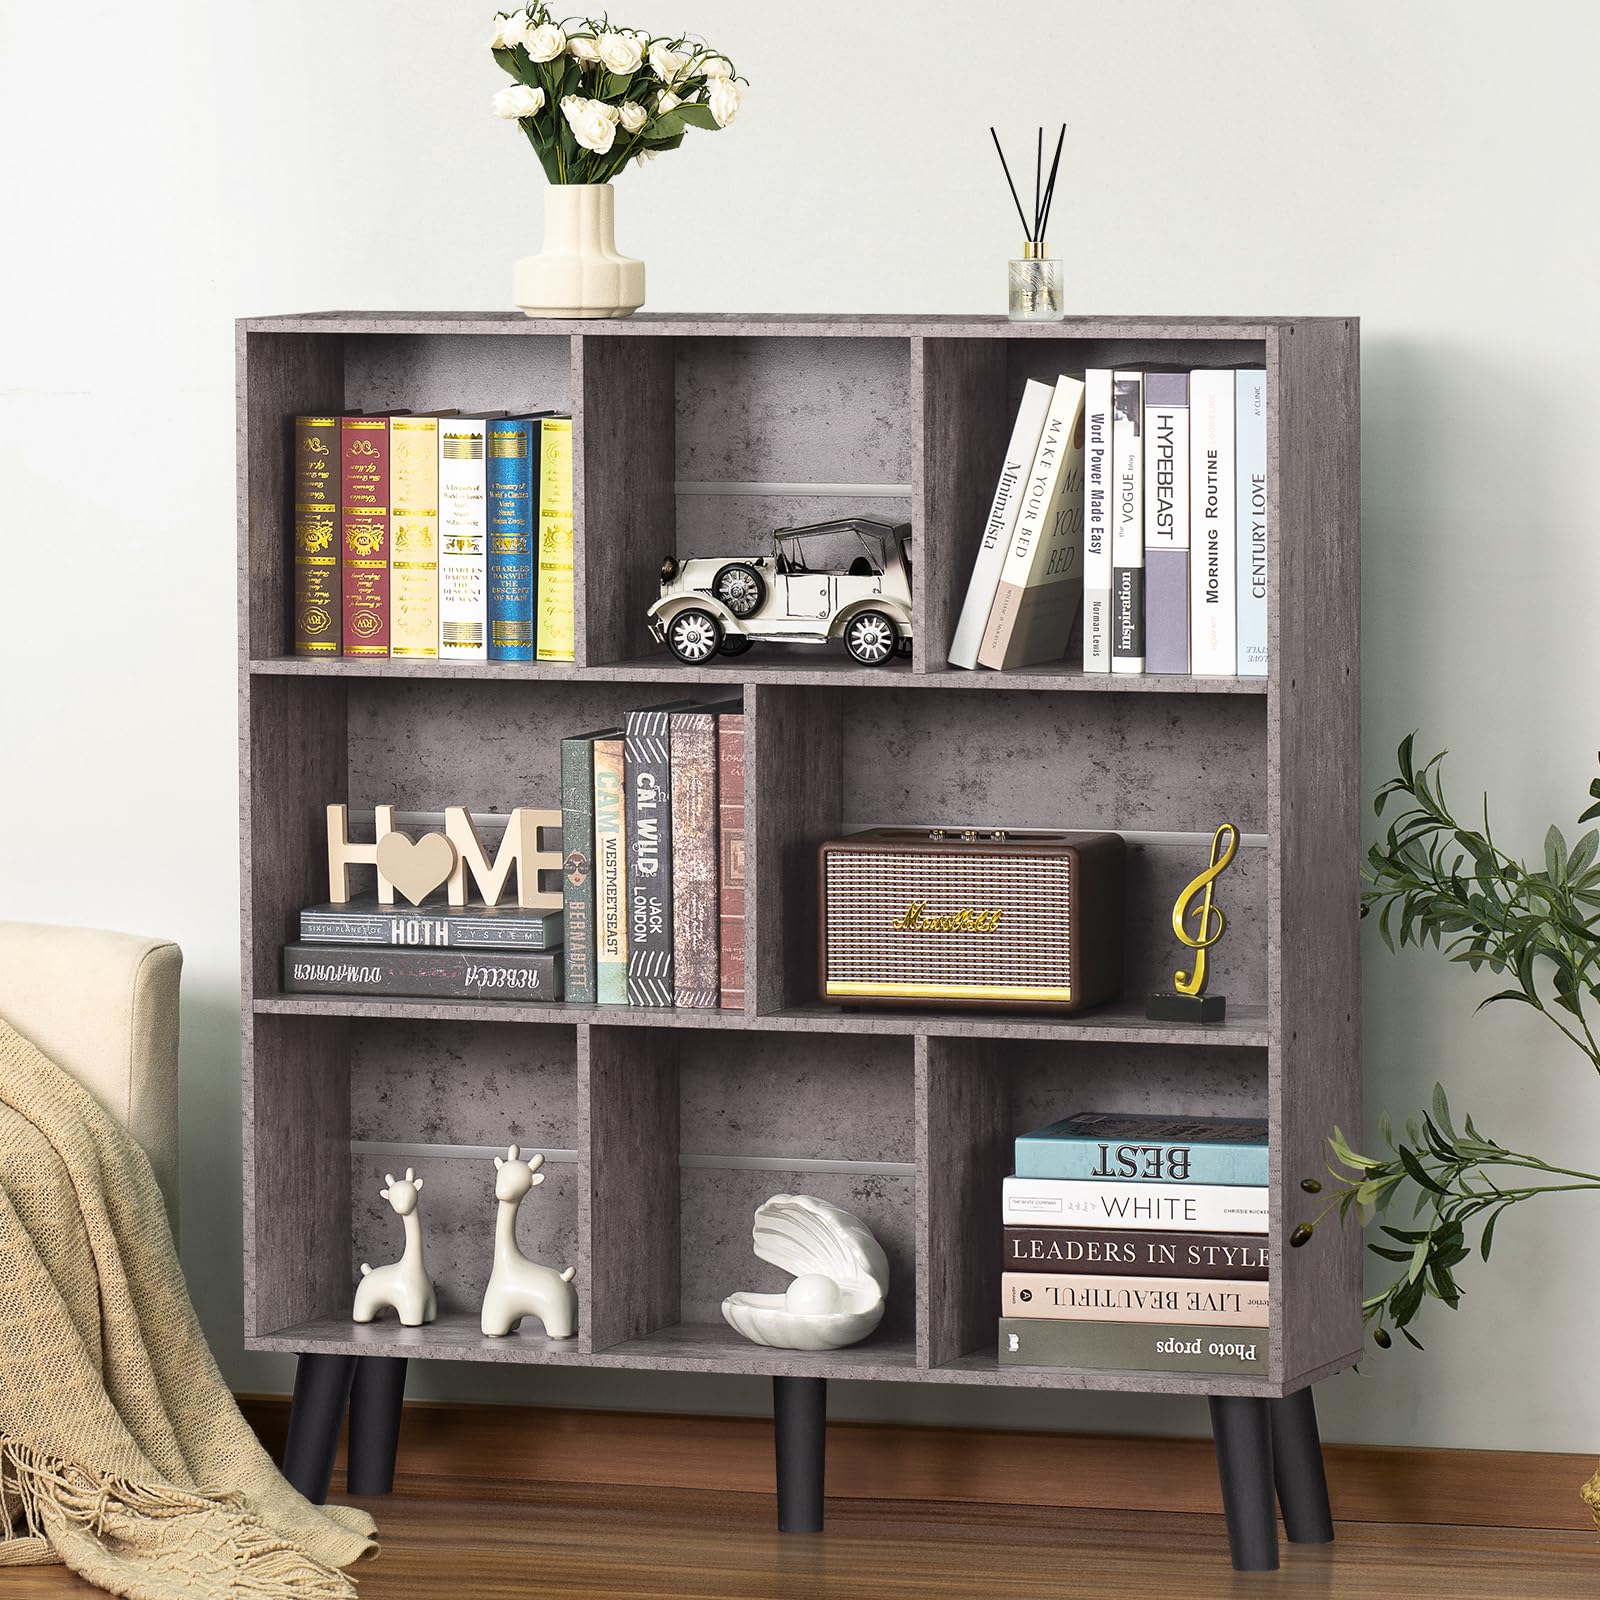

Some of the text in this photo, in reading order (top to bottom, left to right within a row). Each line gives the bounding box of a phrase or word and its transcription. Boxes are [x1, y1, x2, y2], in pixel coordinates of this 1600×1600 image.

[1088, 413, 1105, 555] Word Power Made Easy
[1128, 454, 1136, 471] blog
[1157, 415, 1174, 541] HYPEBEAST
[983, 461, 1021, 549] Minimalista
[1015, 419, 1063, 558] MAKE YOUR BED
[1123, 473, 1134, 523] VOGUE
[1205, 449, 1219, 604] MORNING ROUTINE
[1252, 474, 1266, 599] CENTURY LOVE
[1047, 546, 1075, 576] BED
[357, 619, 373, 628] RW
[1093, 601, 1102, 657] Norman Lewis
[1118, 571, 1135, 650] inspiration
[597, 771, 620, 833] CAM
[636, 772, 658, 811] CAL
[637, 818, 659, 877] WILD
[605, 838, 618, 957] WESTMEETSEAST
[633, 886, 647, 943] LONDON
[649, 896, 663, 934] JACK
[308, 925, 332, 933] SIXTH
[335, 926, 367, 935] PLANET
[391, 919, 449, 946] HOTH
[464, 964, 540, 989] REBECCA
[1090, 1143, 1192, 1180] BEST
[1100, 1195, 1197, 1221] WHITE
[1012, 1239, 1269, 1268] LEADERS IN STYLE
[1045, 1286, 1242, 1313] LIVE BEAUTIFUL
[1156, 1337, 1257, 1361] Photo props
